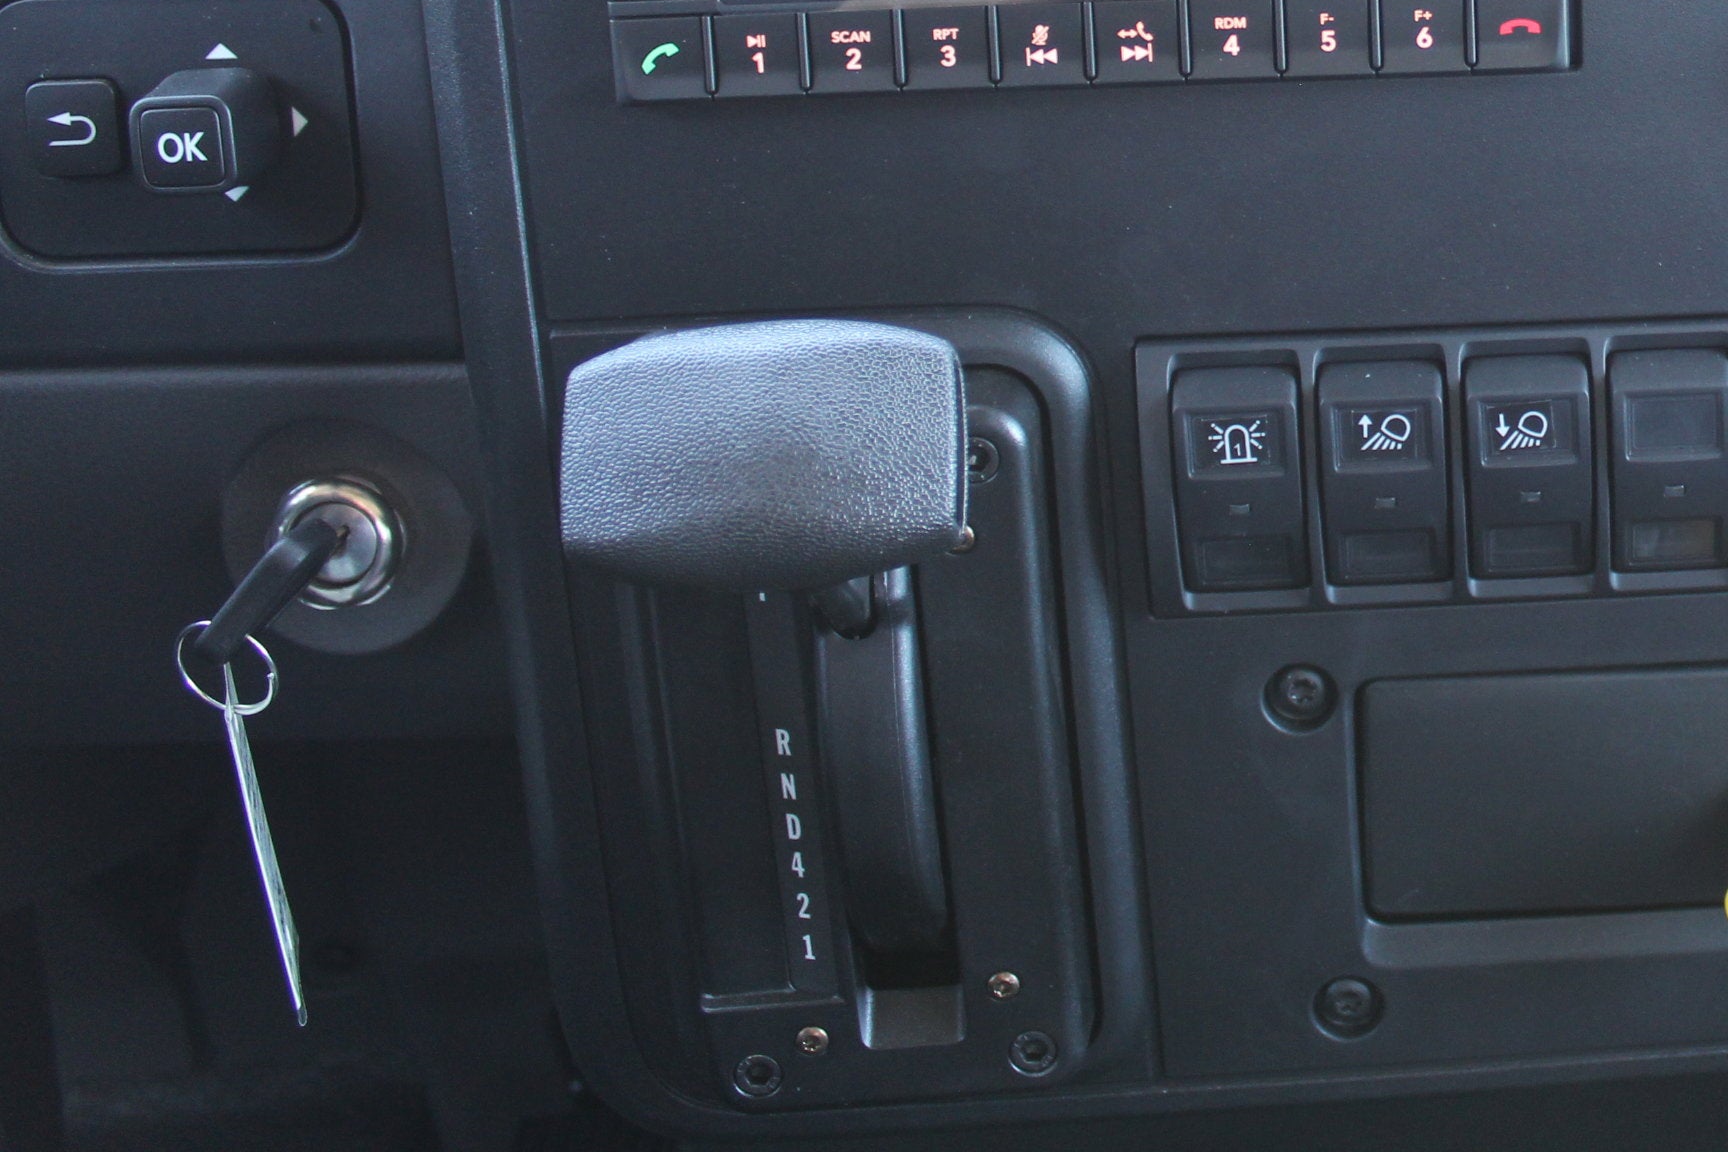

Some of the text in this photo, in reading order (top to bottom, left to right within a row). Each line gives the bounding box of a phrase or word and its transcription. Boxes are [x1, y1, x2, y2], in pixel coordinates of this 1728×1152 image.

[1214, 15, 1247, 30] RDM
[1413, 9, 1433, 23] F+
[830, 30, 872, 45] SCAN
[932, 27, 959, 41] RPT
[1223, 34, 1240, 57] 4
[1320, 29, 1337, 52] 5
[1415, 26, 1434, 49] 6
[751, 52, 765, 74] 1
[845, 47, 862, 71] 2
[940, 45, 957, 68] 3
[156, 131, 208, 164] OK
[774, 727, 792, 756] R
[780, 772, 797, 800] N
[785, 812, 802, 841] D
[791, 851, 806, 879] 4
[796, 892, 811, 920] 2
[802, 933, 816, 961] 1
